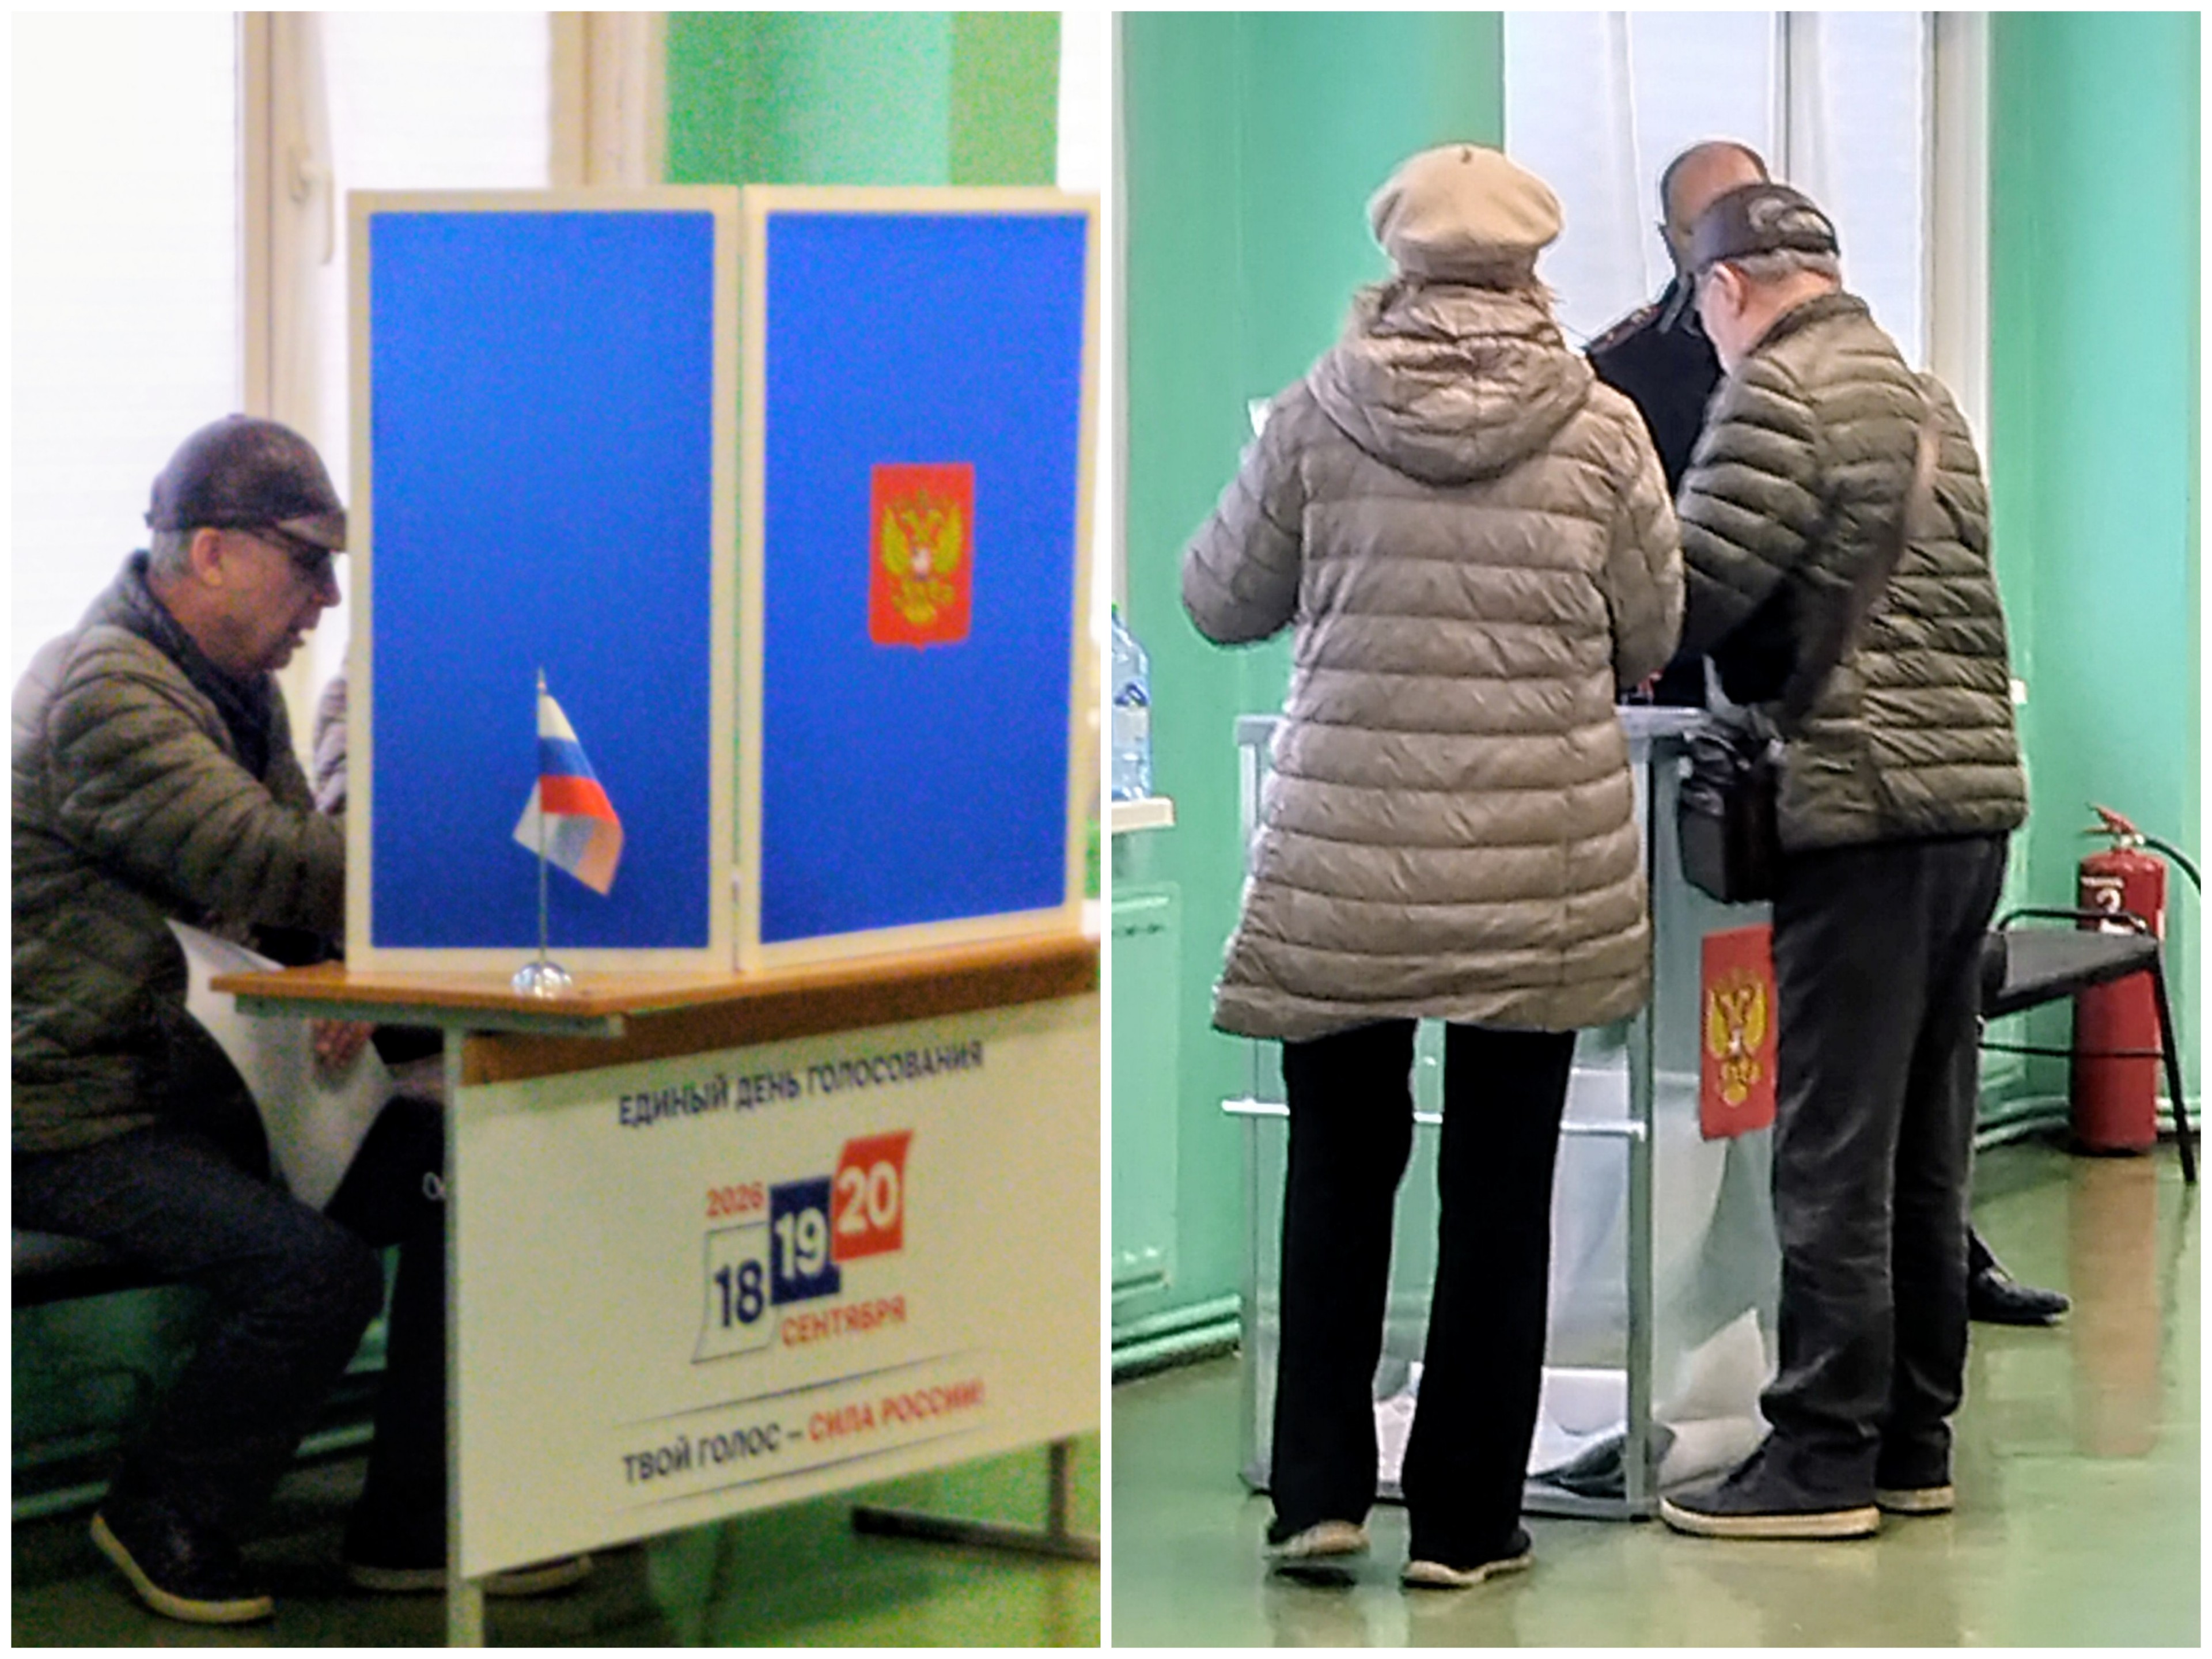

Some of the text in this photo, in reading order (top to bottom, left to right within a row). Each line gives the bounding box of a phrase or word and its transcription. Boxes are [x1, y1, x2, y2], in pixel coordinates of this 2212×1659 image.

[619, 1040, 983, 1128] ЕДИНЫЙ ДЕНЬ ГОЛОСОВАНИЯ
[707, 1182, 764, 1217] 2026
[714, 1161, 897, 1327] 18 19 20
[782, 1295, 906, 1347] СЕНТЯБРЯ
[623, 1435, 691, 1483] ТВОЙ
[698, 1423, 780, 1465] ГОЛОС
[809, 1404, 874, 1441] СИЛА
[881, 1380, 983, 1423] РОССИИ!
